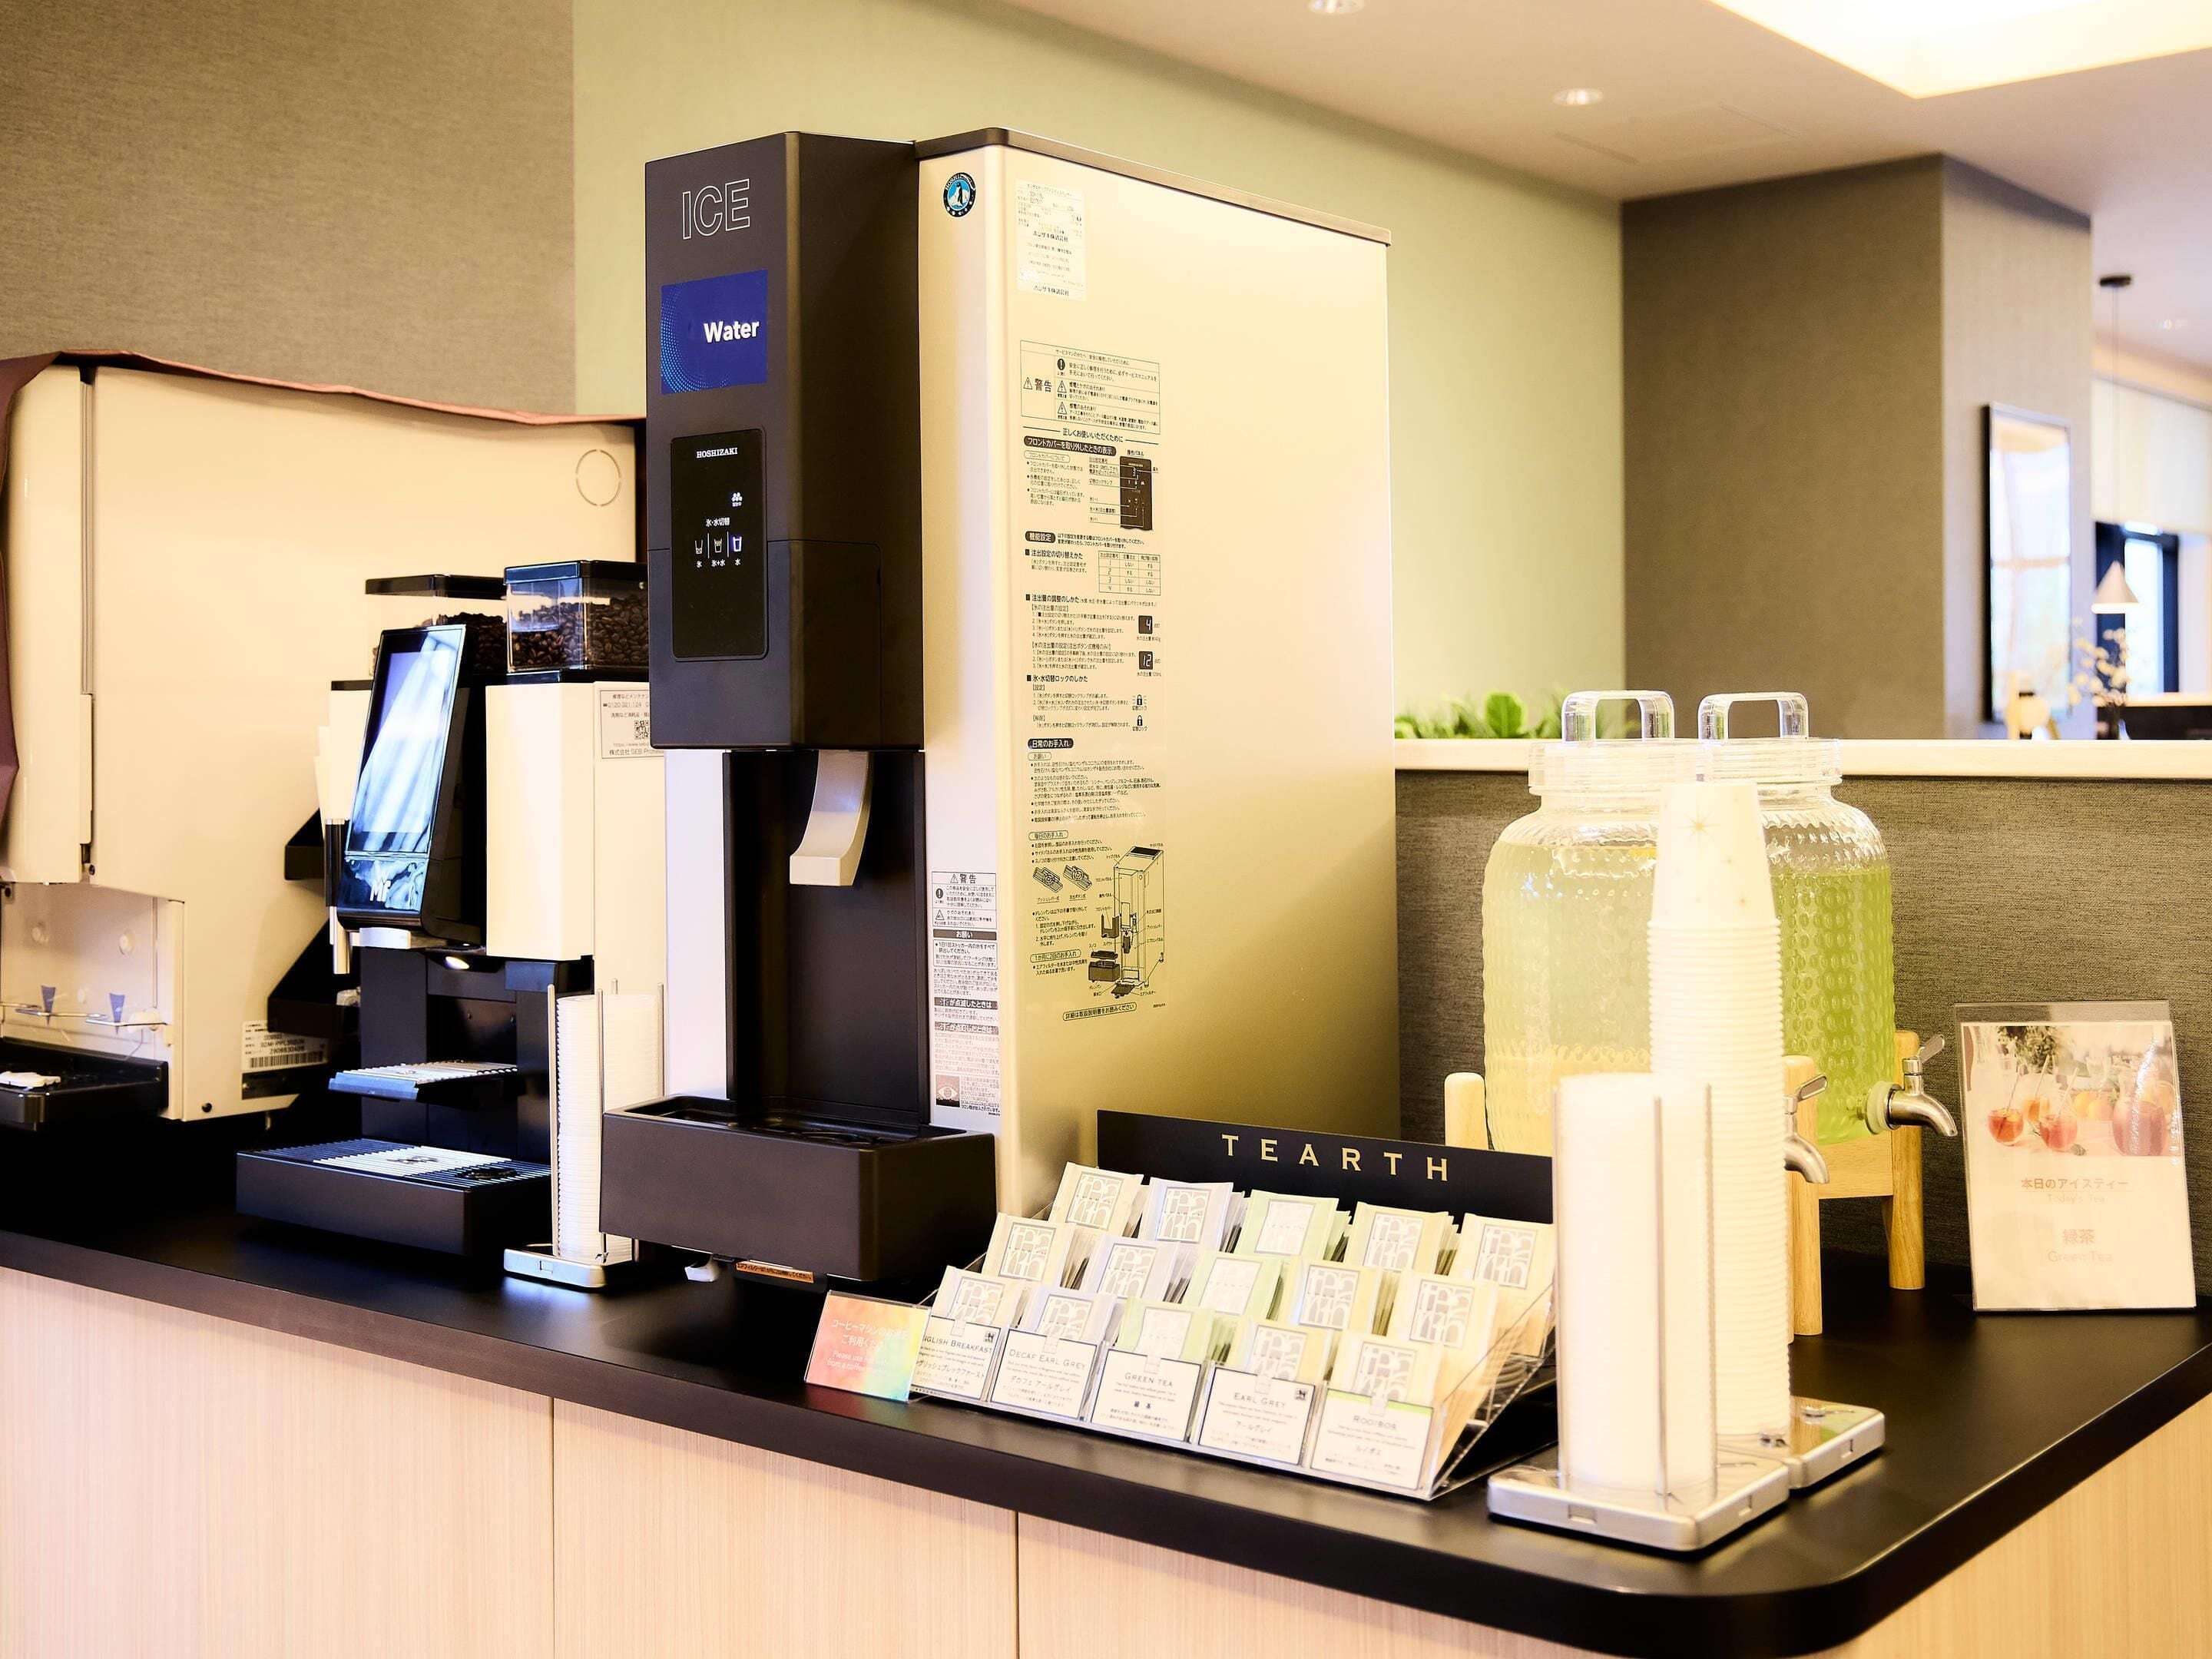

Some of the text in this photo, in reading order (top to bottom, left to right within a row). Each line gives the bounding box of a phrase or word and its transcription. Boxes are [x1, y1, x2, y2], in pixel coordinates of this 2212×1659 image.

[682, 177, 750, 240] ICE
[704, 319, 760, 343] Water
[1035, 379, 1051, 392] 警告
[1063, 428, 1122, 442] 正しくお使いいただくために
[1028, 437, 1112, 455] フロントカバーを取り外したときの表示
[696, 447, 738, 459] HOSHIZAKI
[1029, 532, 1051, 541] 機能設定
[1031, 548, 1082, 560] 注出設定の切り替えかた
[1031, 594, 1078, 603] 注出量の調整のしかた
[1146, 619, 1151, 630] 4
[1143, 654, 1151, 666] 12
[960, 874, 976, 884] 警告
[1222, 1133, 1449, 1182] TEARTH
[2021, 1177, 2129, 1190] 本日のアイスティー
[2062, 1228, 2095, 1245] 緑茶
[2048, 1250, 2086, 1262] Green
[951, 1339, 994, 1354] BREAKFAST
[1009, 1349, 1086, 1370] DECAF EARL GREY
[1124, 1372, 1173, 1387] GREEN TEA
[1234, 1392, 1286, 1408] EARL GREY
